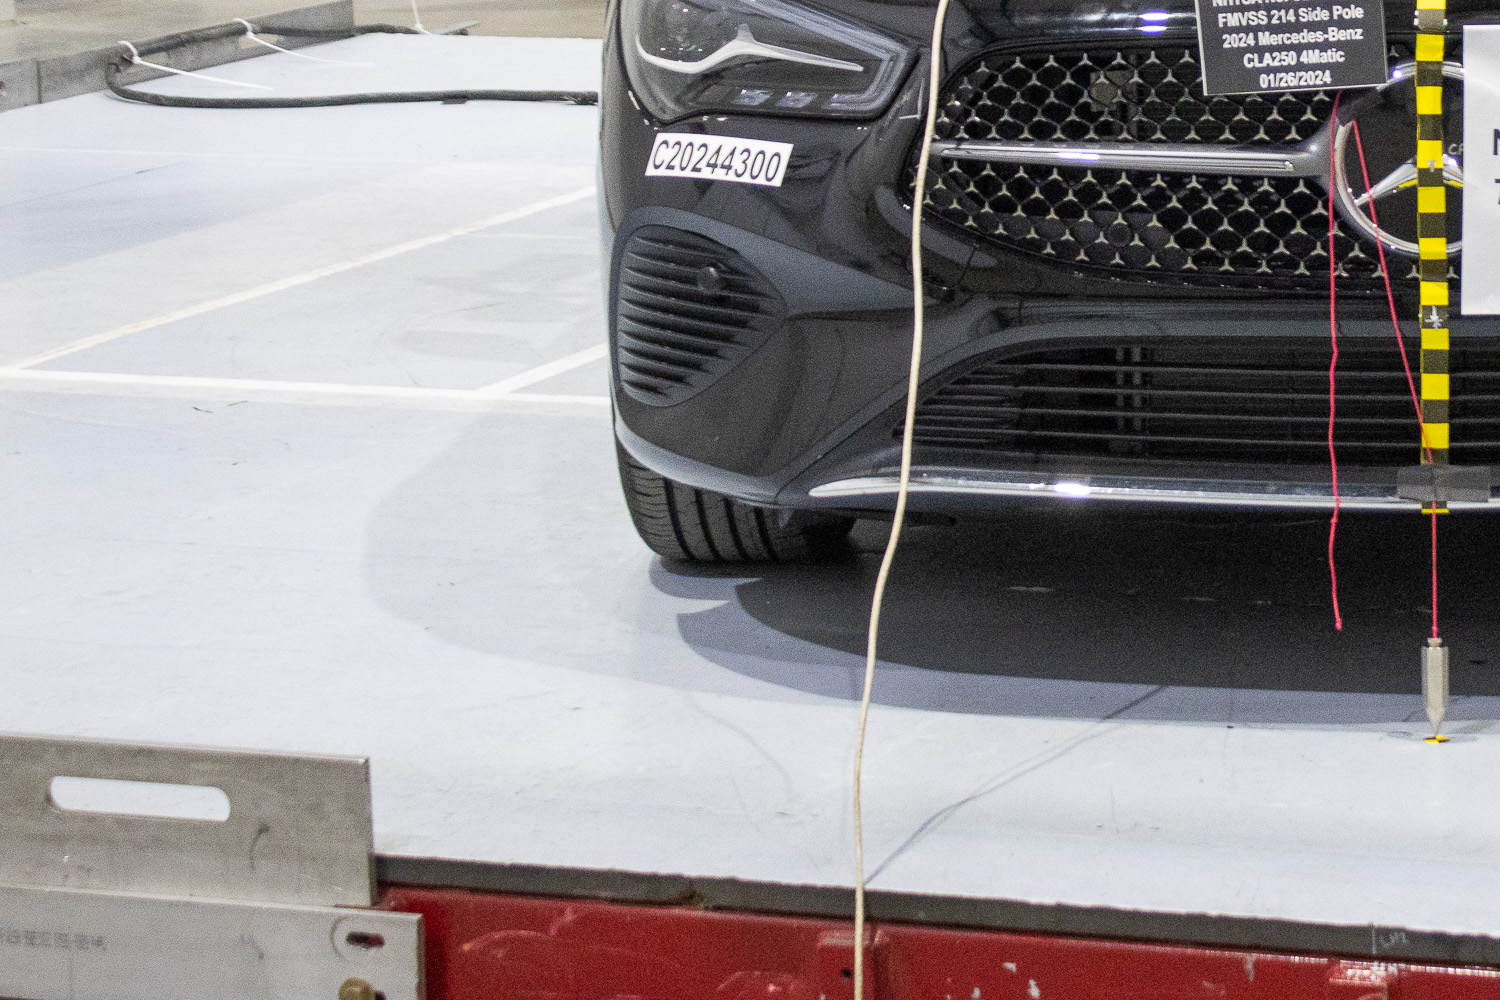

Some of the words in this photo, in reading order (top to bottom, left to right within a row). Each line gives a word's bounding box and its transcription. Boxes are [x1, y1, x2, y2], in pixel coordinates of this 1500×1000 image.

[1218, 11, 1268, 27] FMVSS
[1271, 9, 1296, 24] 214
[1299, 7, 1329, 22] Side
[1333, 5, 1364, 19] Pole
[1223, 34, 1255, 48] 2024
[1258, 27, 1363, 45] Mercedes-Benz
[1244, 51, 1297, 68] CLA250
[1300, 48, 1345, 64] 4Matic
[1260, 70, 1333, 89] 01/26/2024
[653, 139, 782, 183] C20244300
